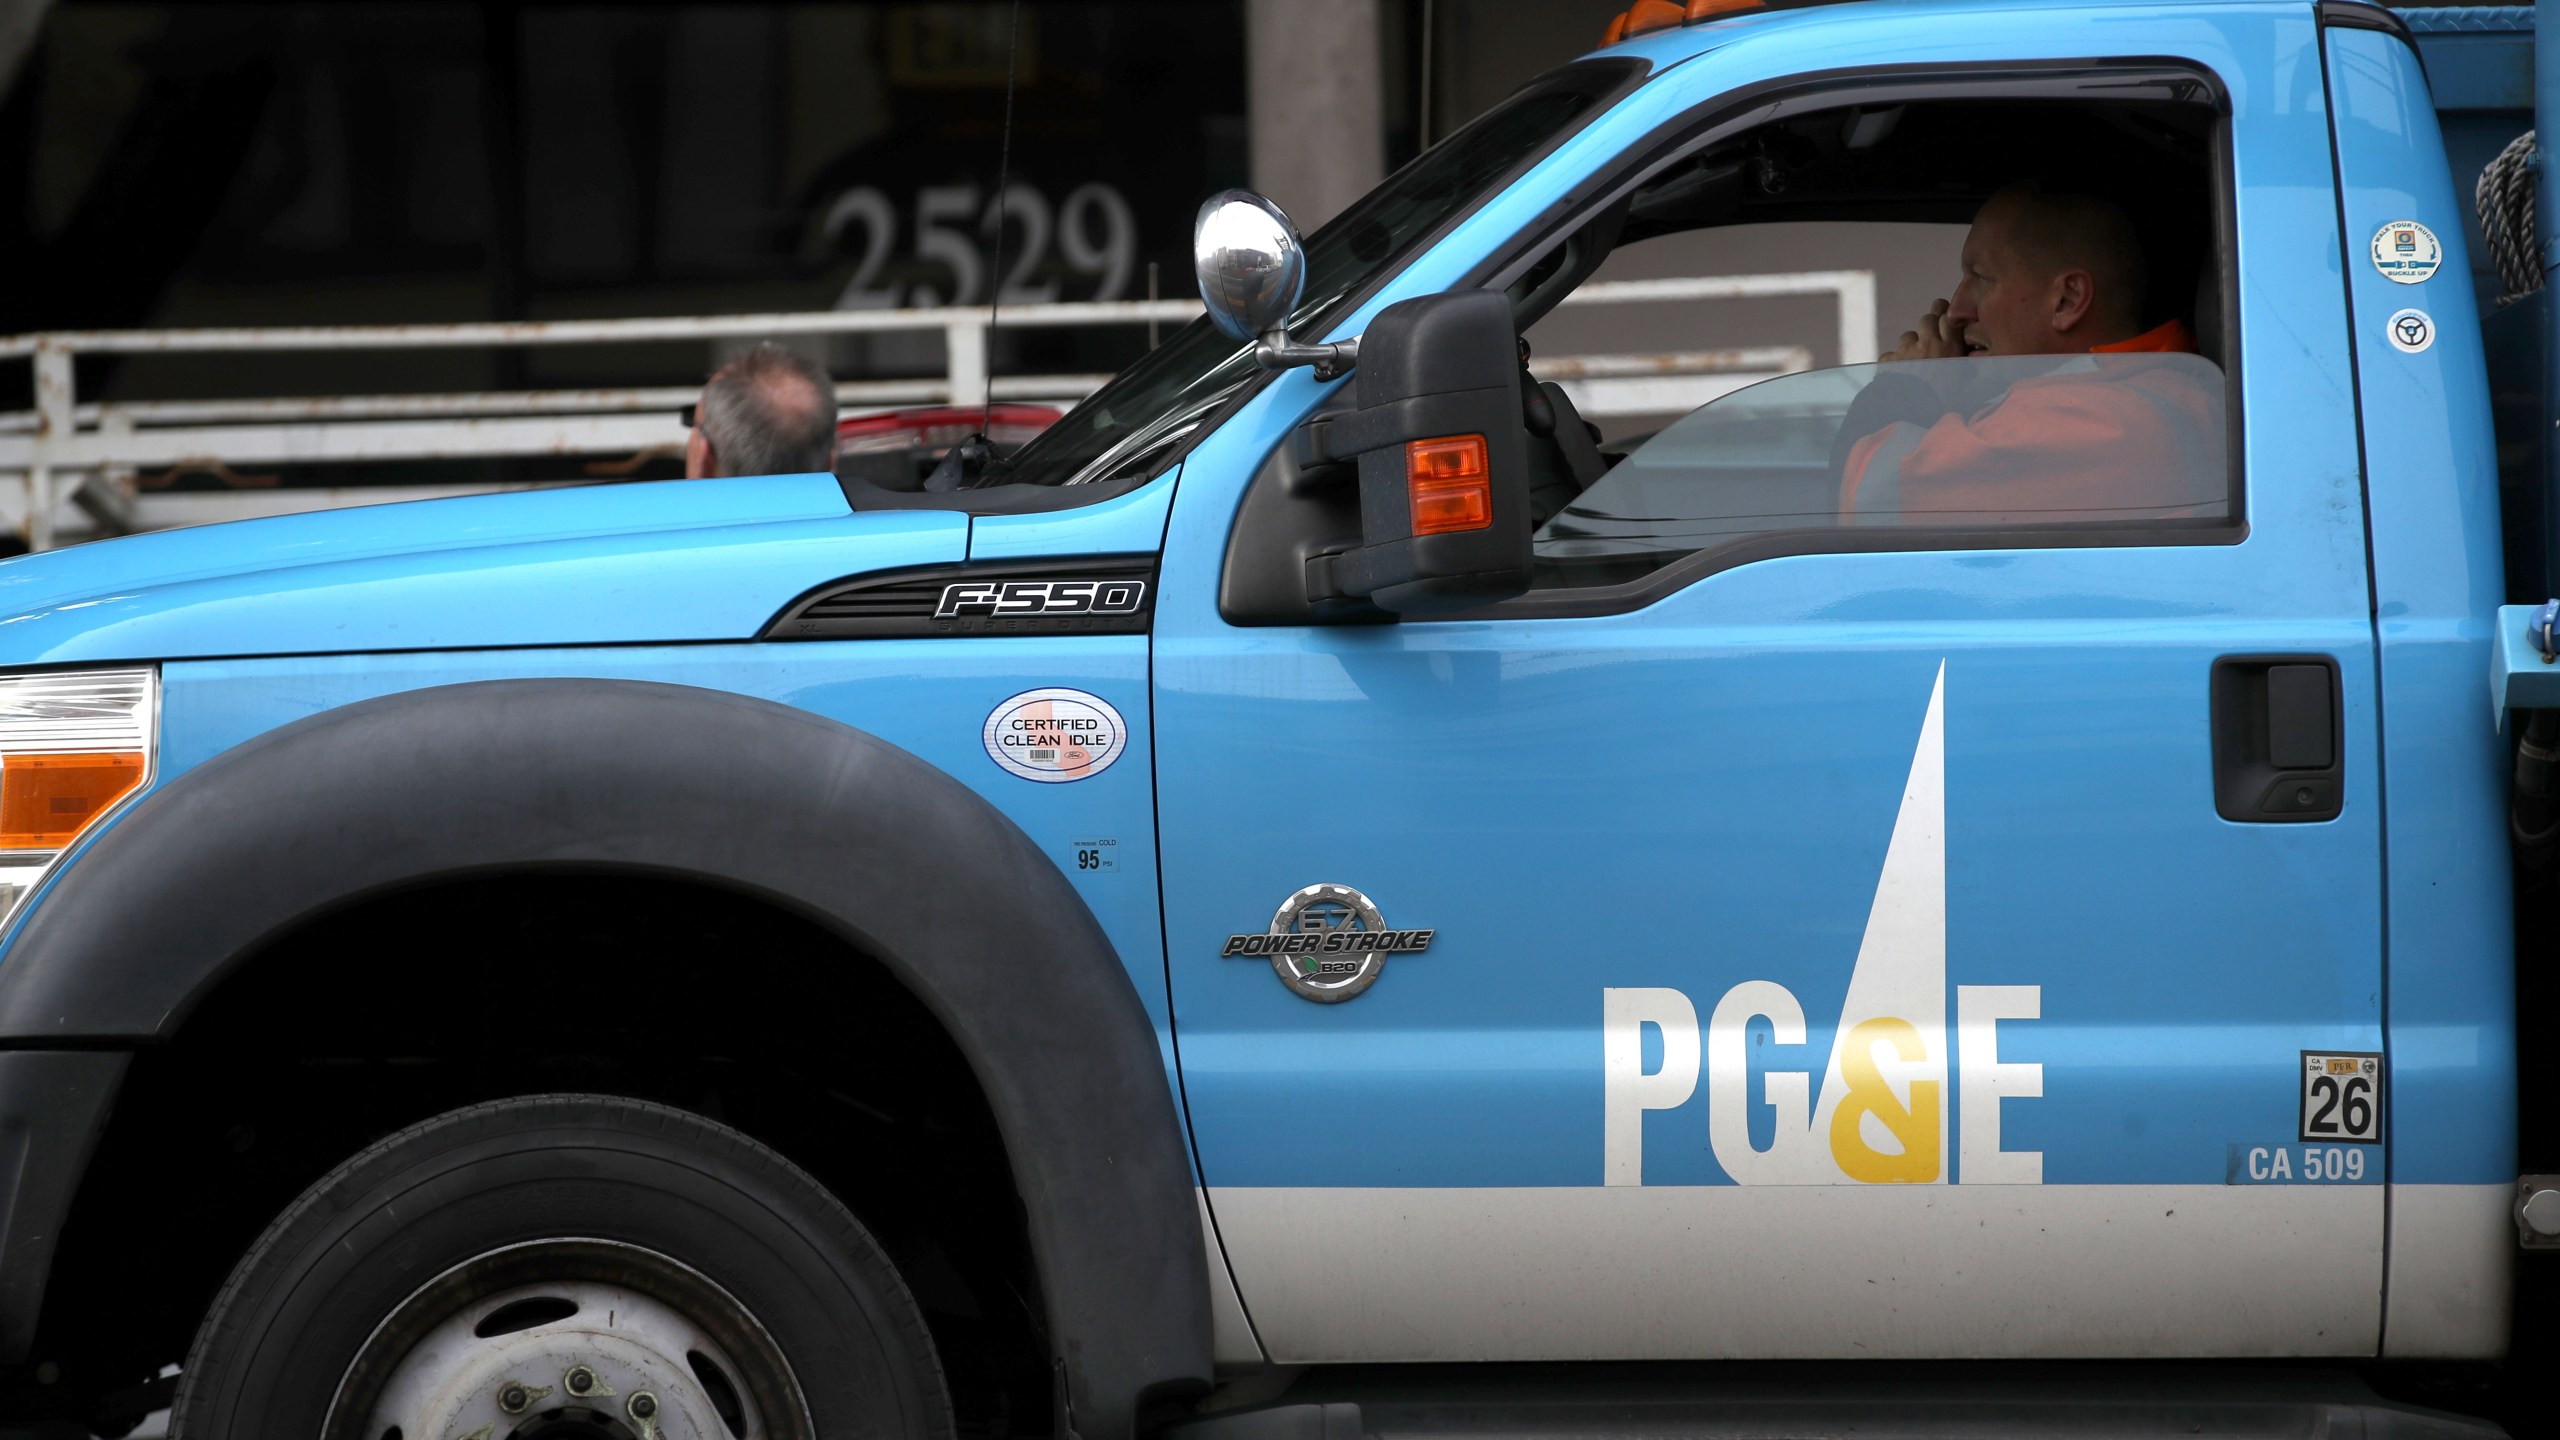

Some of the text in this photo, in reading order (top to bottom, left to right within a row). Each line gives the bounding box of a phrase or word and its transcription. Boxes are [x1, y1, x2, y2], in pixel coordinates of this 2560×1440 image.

[2374, 227, 2391, 243] WALK
[2414, 224, 2435, 244] TRUCK
[824, 184, 1138, 310] 2529
[935, 581, 1146, 618] F-550
[939, 619, 1136, 631] SUPER DUTY
[1012, 719, 1098, 731] CERTIFIED
[1003, 734, 1106, 746] CLEAN IDLE
[1078, 849, 1100, 870] 95
[1222, 929, 1435, 957] POWER STROKE
[1321, 962, 1356, 973] B20
[1603, 980, 2044, 1186] PG&E
[2309, 1075, 2372, 1136] 26
[2248, 1147, 2365, 1181] CA 509
